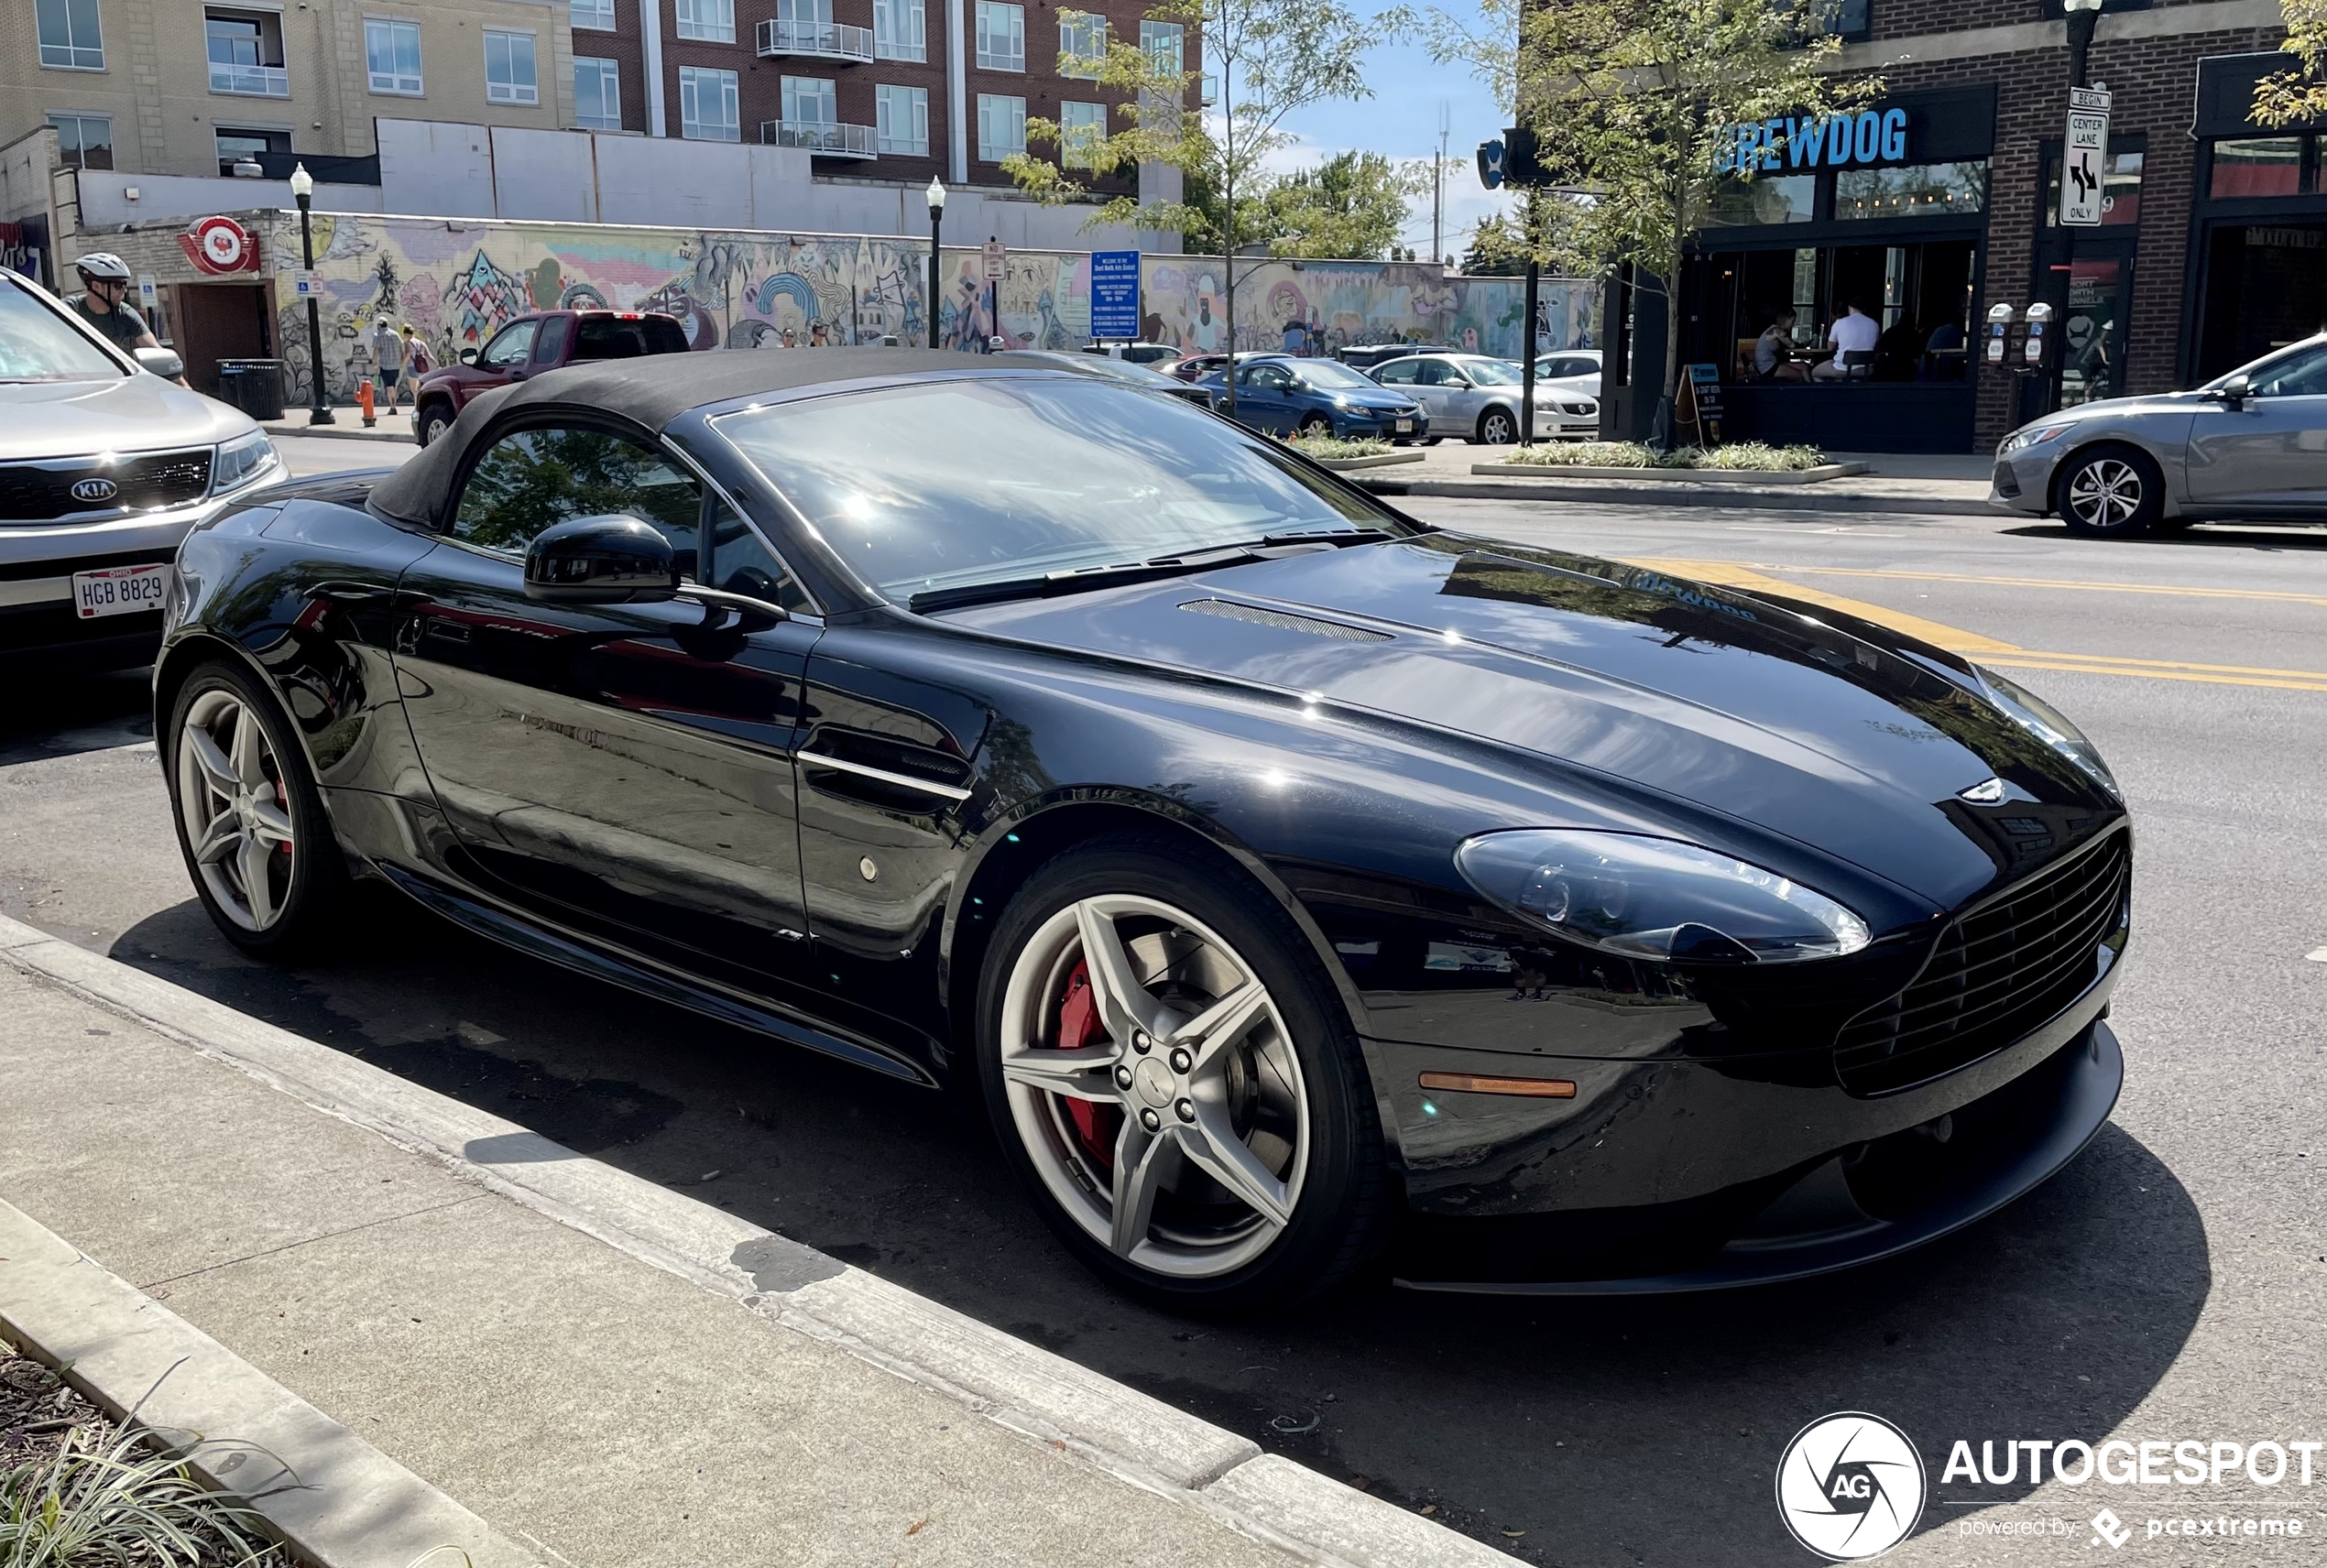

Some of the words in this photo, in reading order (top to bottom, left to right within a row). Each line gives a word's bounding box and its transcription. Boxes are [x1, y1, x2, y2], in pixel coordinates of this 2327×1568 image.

[2078, 93, 2103, 106] BEGIN
[2072, 118, 2103, 131] CENTER
[2076, 133, 2097, 145] LANE
[2070, 207, 2092, 219] ONLY
[989, 245, 999, 253] NO
[2070, 280, 2095, 289] HORT
[79, 483, 112, 497] KIA
[108, 569, 132, 578] OHIO
[82, 582, 115, 606] HGB
[120, 576, 163, 602] 8829
